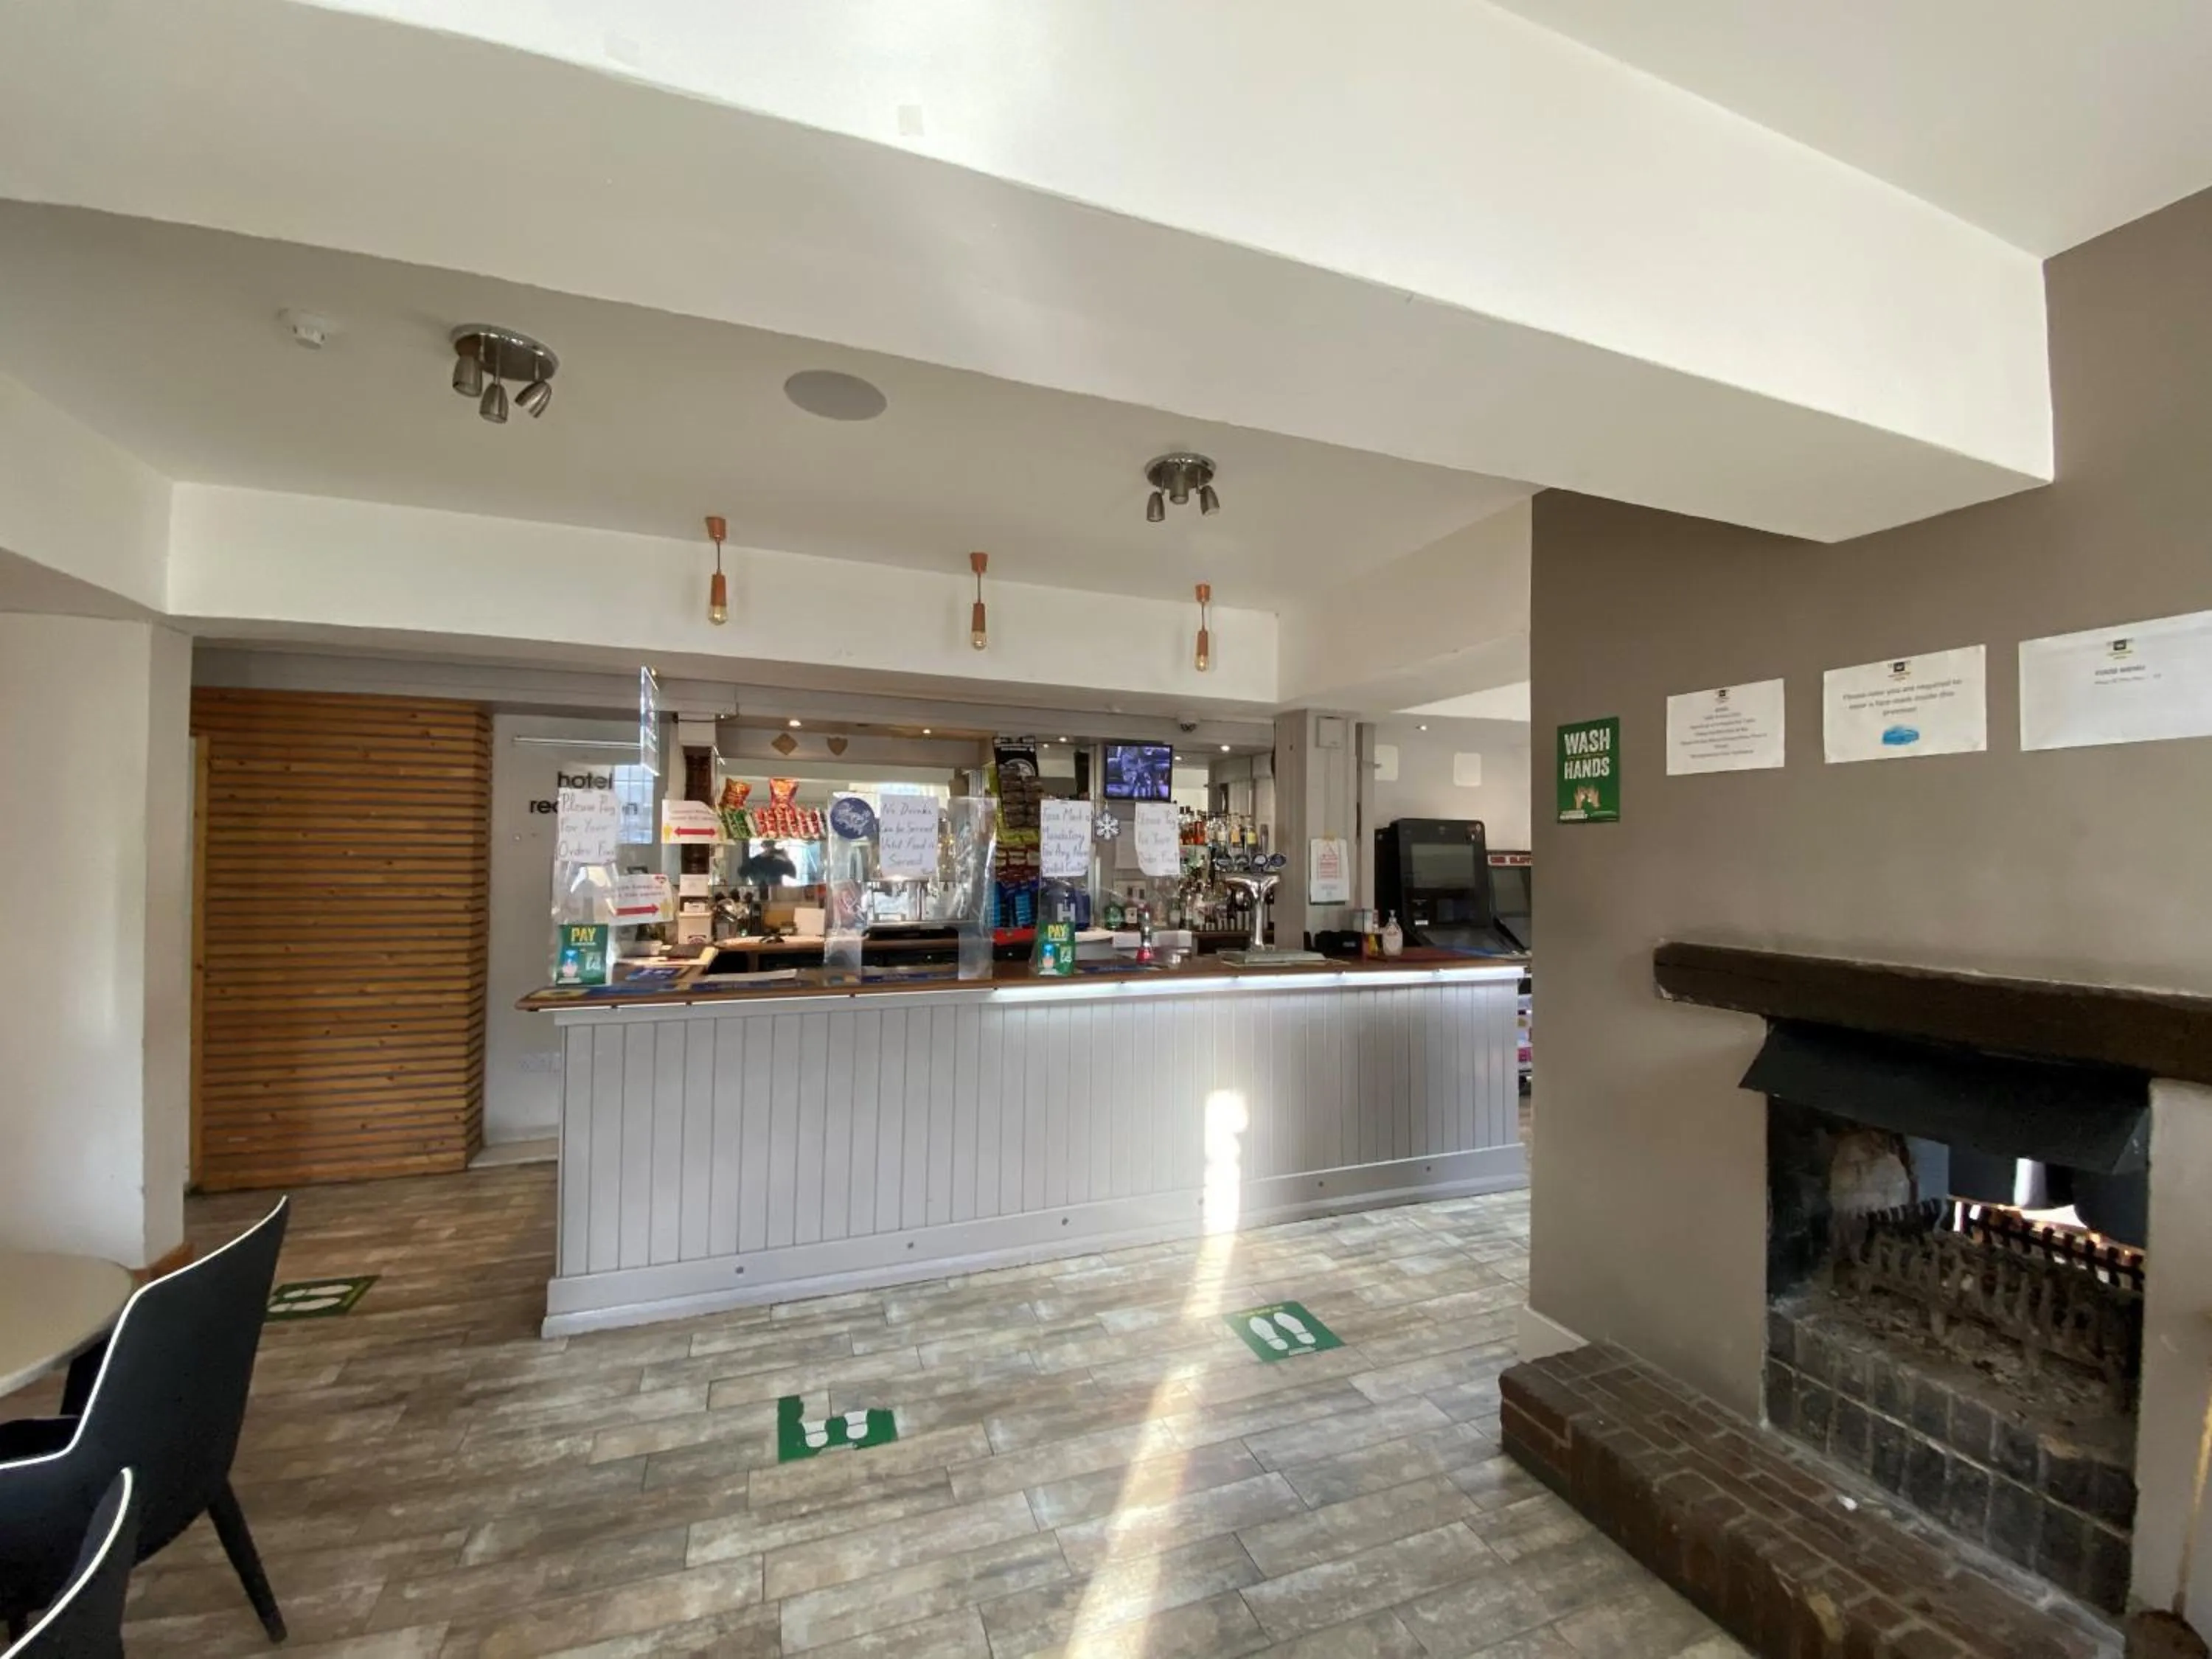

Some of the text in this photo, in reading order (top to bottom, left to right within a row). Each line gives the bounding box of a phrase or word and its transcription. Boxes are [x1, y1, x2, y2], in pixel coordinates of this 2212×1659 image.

[1564, 728, 1610, 756] WASH
[1564, 757, 1610, 779] HANDS
[557, 771, 613, 789] hotel
[571, 926, 597, 942] PAY
[1048, 924, 1069, 939] PAY
